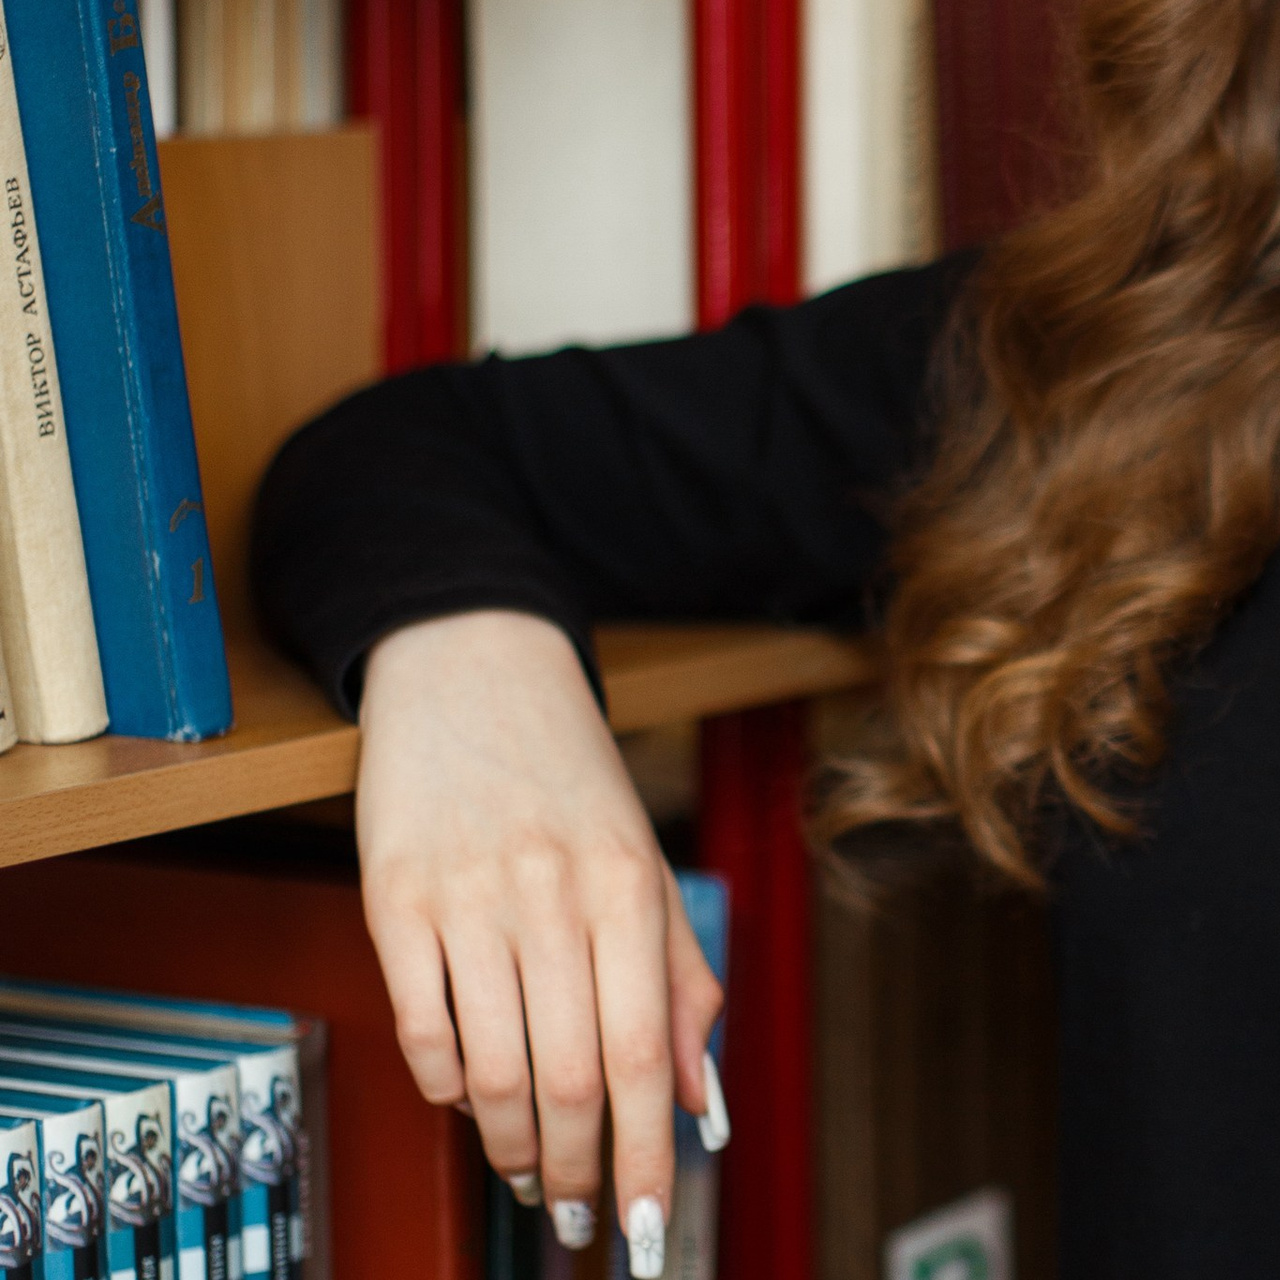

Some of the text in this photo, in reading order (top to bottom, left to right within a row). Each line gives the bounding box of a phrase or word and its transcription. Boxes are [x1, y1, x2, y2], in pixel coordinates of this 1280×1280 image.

[123, 70, 166, 236] Александр
[5, 176, 56, 439] ВИКТОР АСТАФЬЕВ
